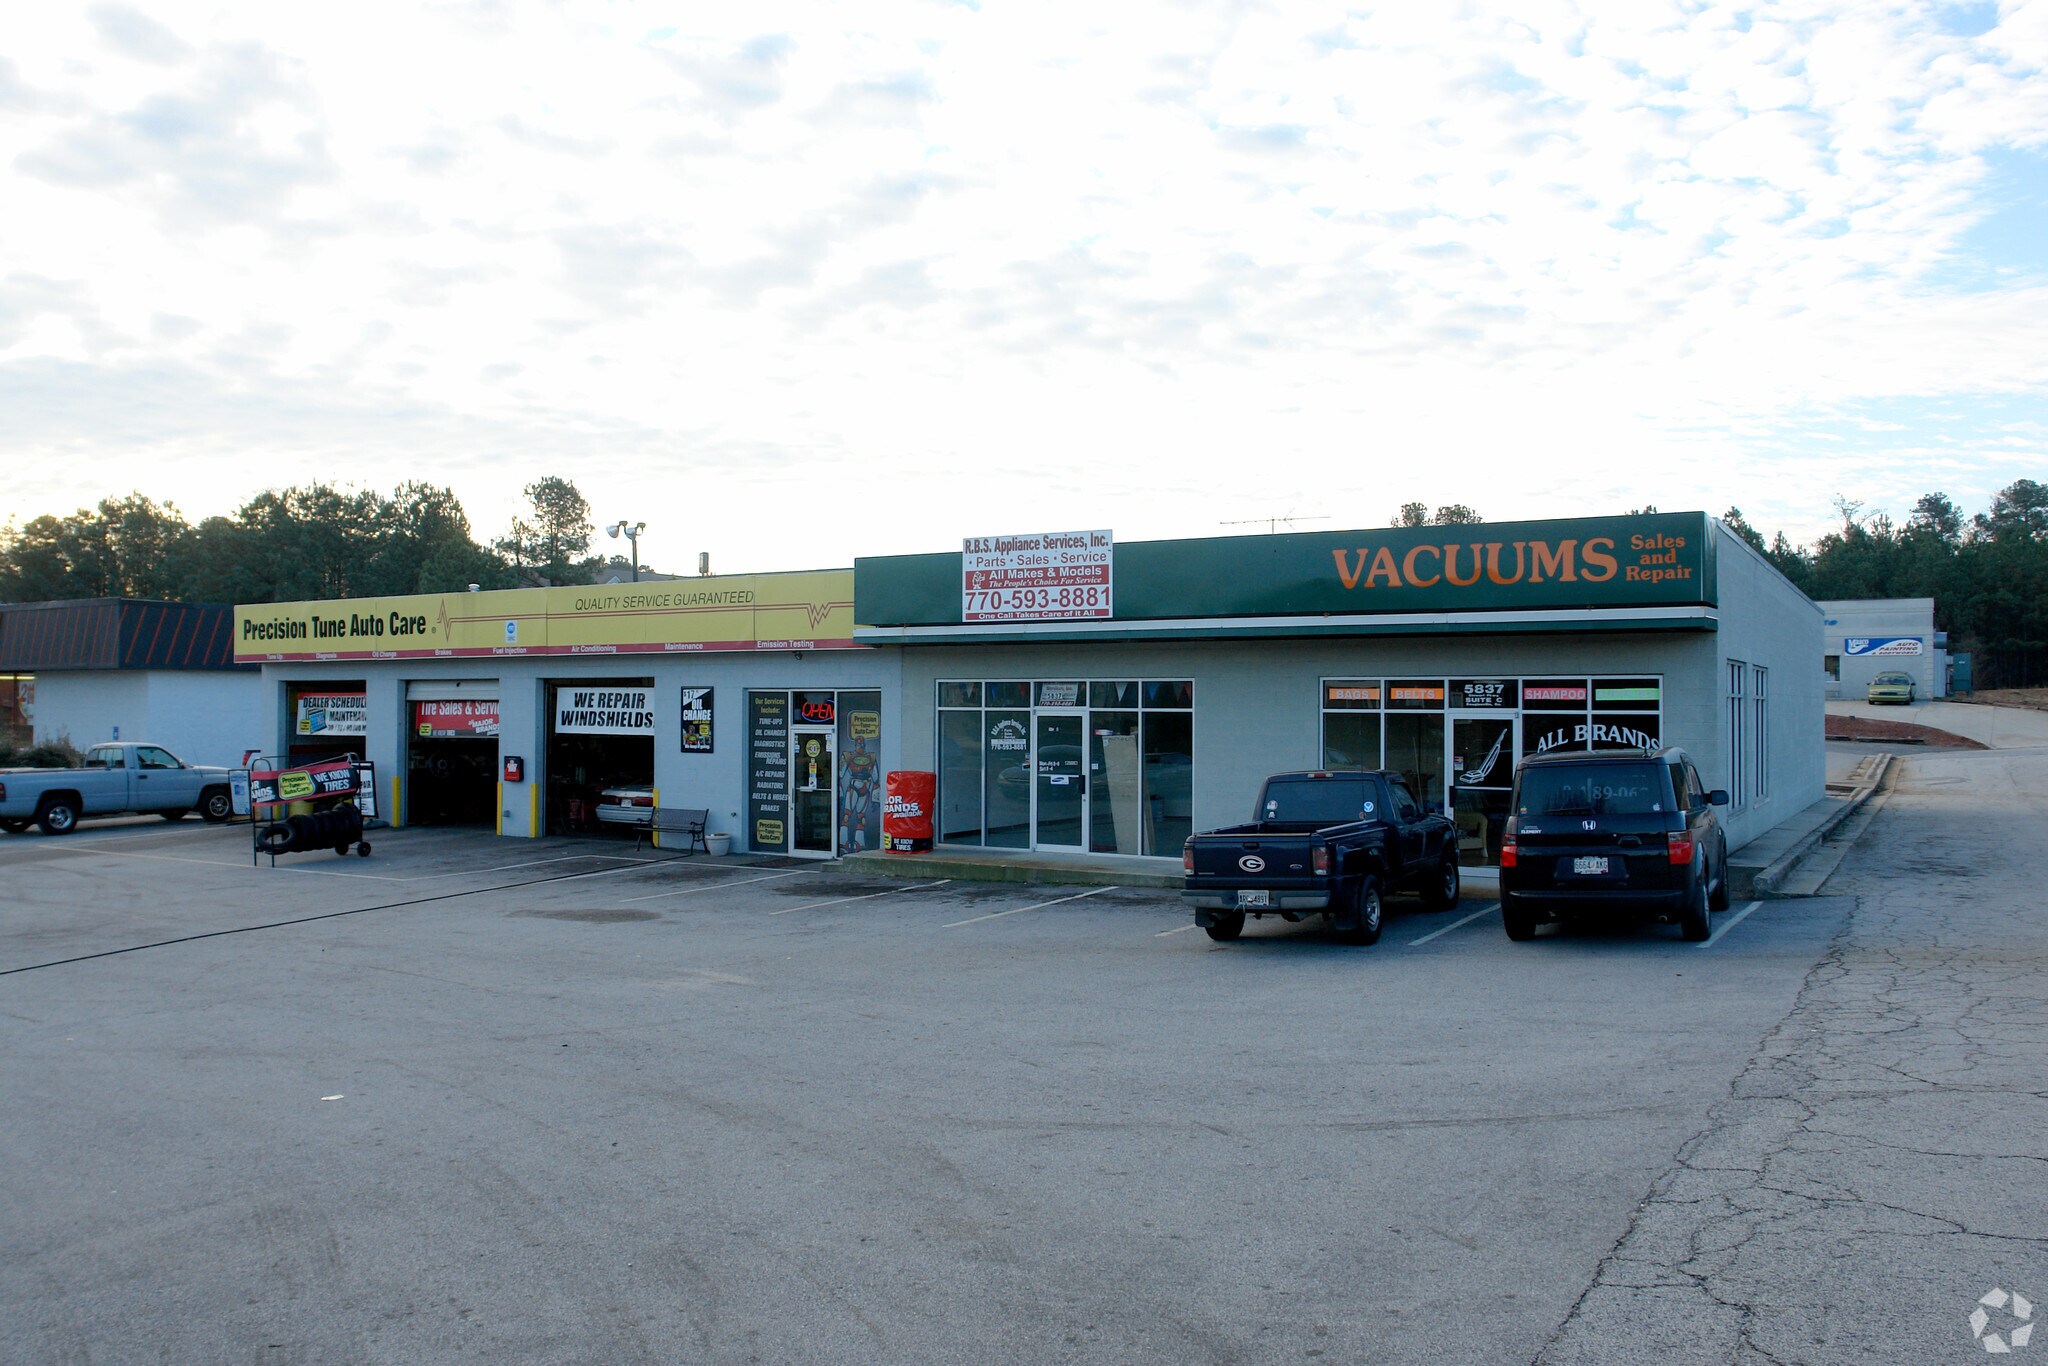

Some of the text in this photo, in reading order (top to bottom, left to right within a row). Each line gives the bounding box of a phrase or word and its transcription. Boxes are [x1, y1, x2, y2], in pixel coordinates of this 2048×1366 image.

[965, 532, 1109, 555] R.B.S. Appliance Services, Inc.
[1630, 533, 1685, 551] Sales
[976, 551, 1107, 568] Parts Sales Service
[1639, 548, 1677, 565] and
[1332, 537, 1619, 589] VACUUMS
[989, 566, 1102, 580] All Makes & Models
[1625, 565, 1693, 584] Repair
[1003, 579, 1033, 588] People's
[1034, 578, 1059, 586] Choice
[1060, 577, 1074, 585] For
[1075, 576, 1102, 584] Service
[575, 590, 754, 611] QUALITY SERVICE GUARANTEED
[965, 586, 1110, 611] 770-593-8881
[978, 612, 995, 620] One
[998, 611, 1014, 619] Call
[1015, 611, 1039, 619] Takes
[1042, 610, 1062, 618] Care
[1083, 609, 1095, 617] All
[243, 611, 426, 640] Precision Tune Auto Care
[571, 644, 616, 653] Air Conditioning
[757, 639, 814, 649] Emission Testing
[505, 646, 527, 655] Injection
[1336, 689, 1369, 700] BAGS
[1395, 689, 1436, 700] BELTS
[1464, 684, 1505, 694] 5837
[1525, 689, 1586, 700] SHAMPOO
[303, 694, 366, 709] DEALER SCHEDUL
[574, 692, 646, 709] WE REPAIR
[692, 699, 703, 710] OIL
[764, 697, 785, 705] Services
[421, 700, 499, 716] Tire Sales & Servic
[802, 701, 835, 719] OPEN
[683, 709, 711, 721] CHANGE
[759, 717, 783, 725] TUNE-UPS
[754, 740, 786, 748] DIAGNOSTICS
[1537, 724, 1660, 753] ALL BRANDS
[281, 775, 306, 784] Precision
[314, 768, 350, 783] WE KNOW
[764, 770, 786, 778] REPAIRS
[323, 778, 350, 792] TIRES
[756, 781, 784, 789] RADIATORS
[752, 792, 767, 800] BELTS
[760, 804, 780, 812] BRAKES
[893, 809, 923, 818] available
